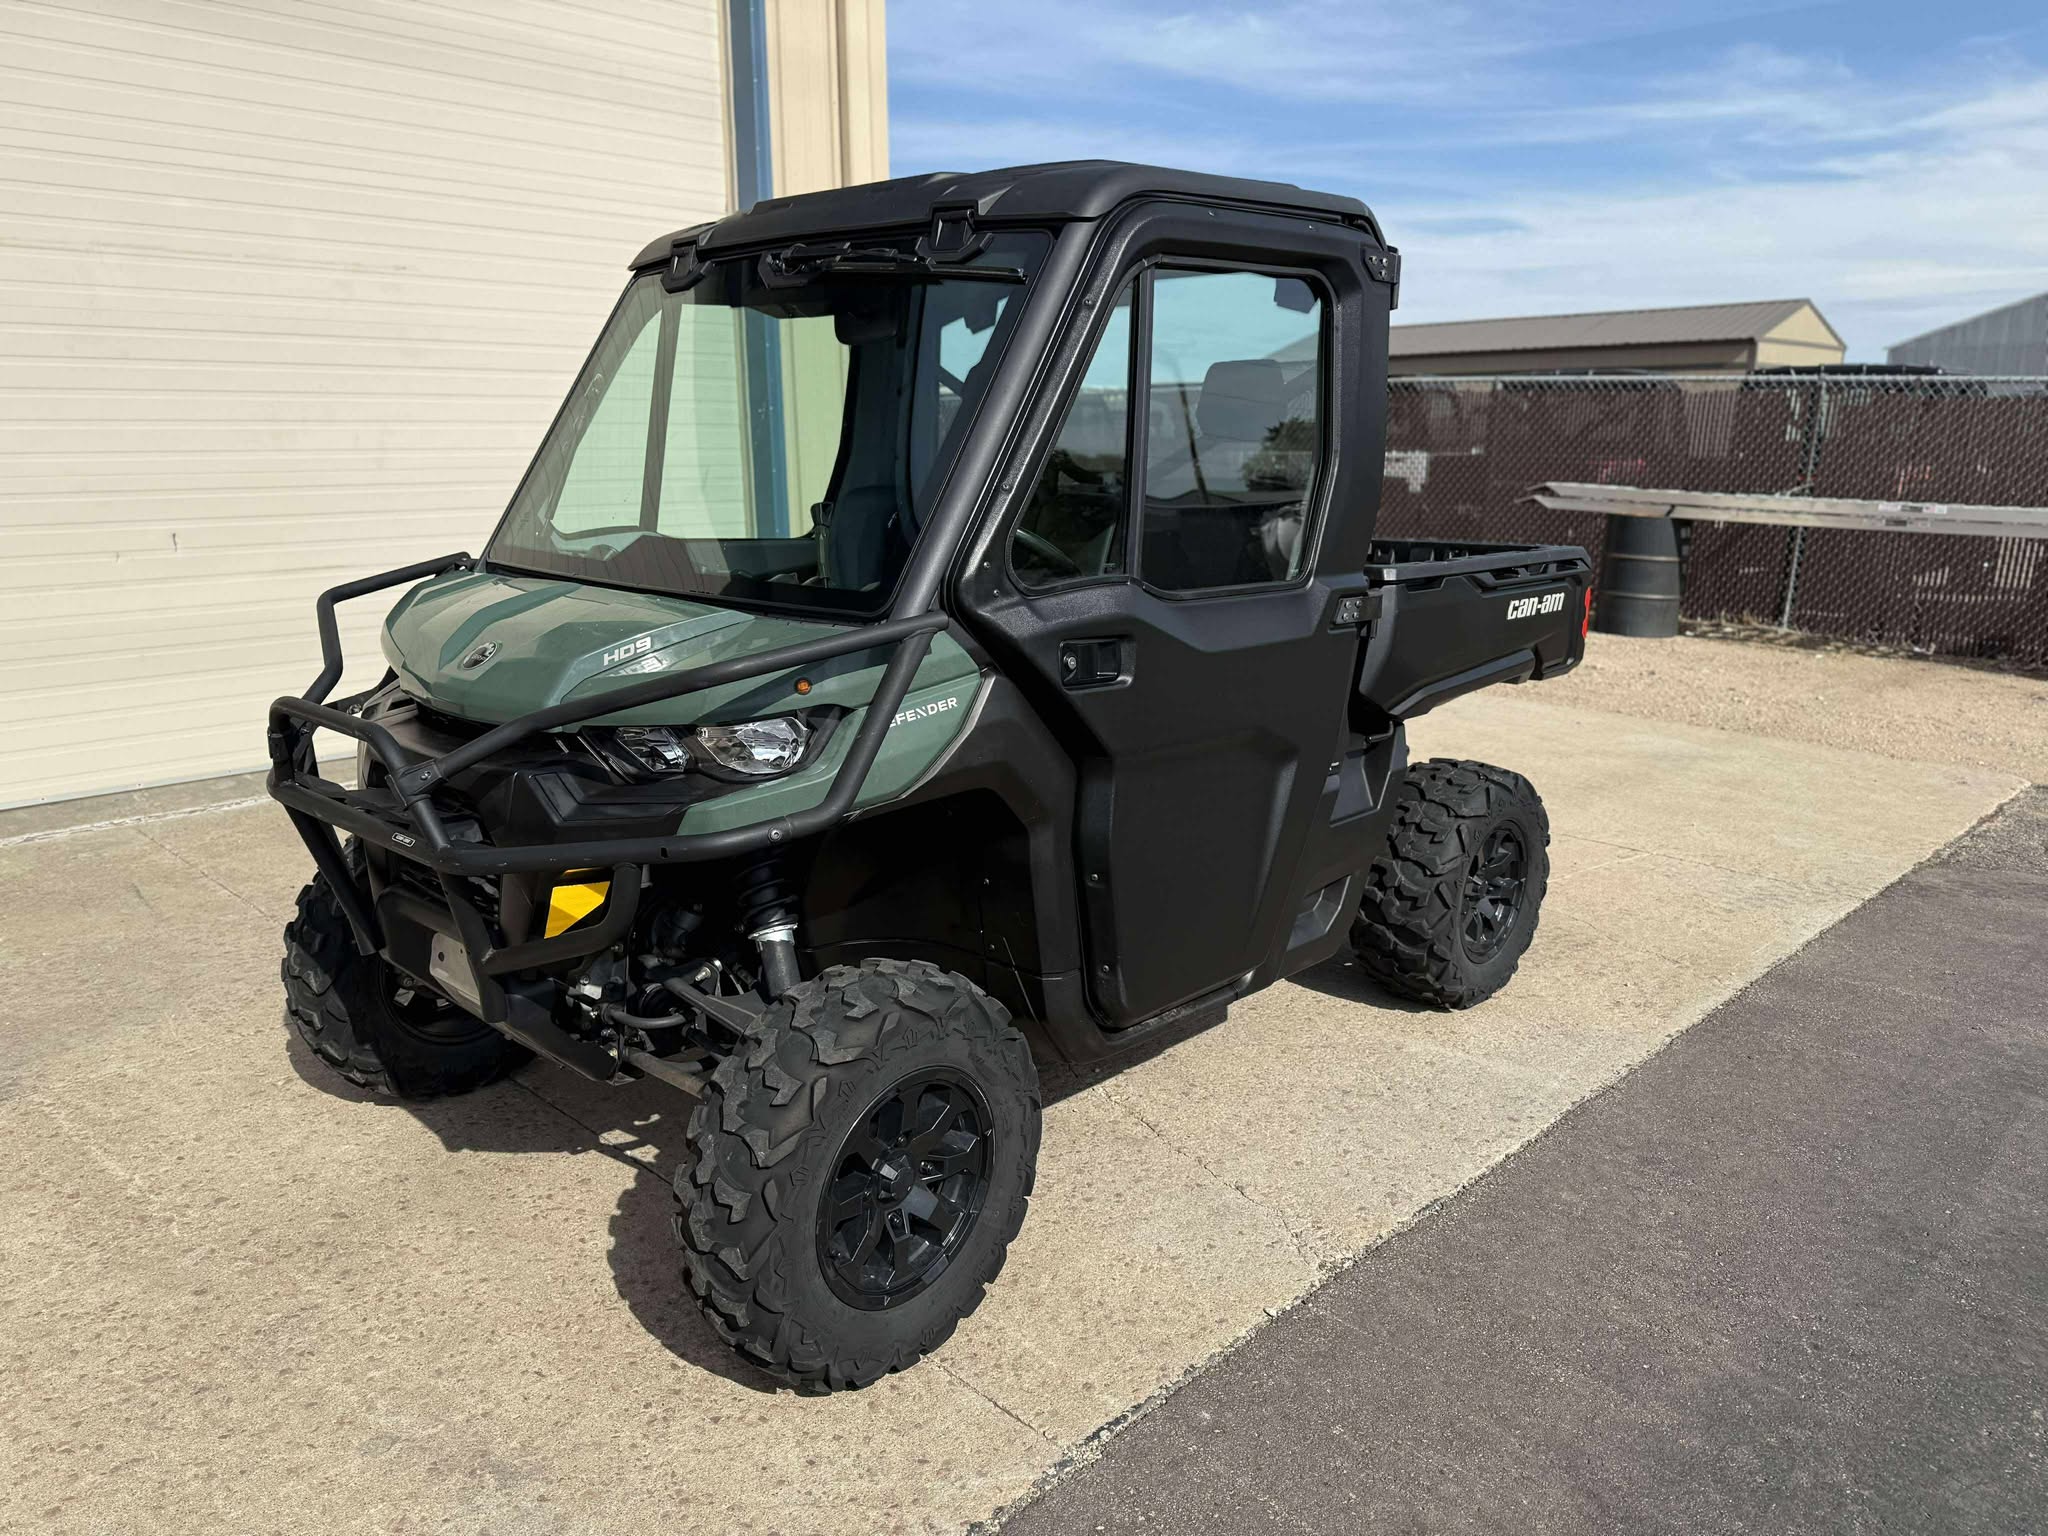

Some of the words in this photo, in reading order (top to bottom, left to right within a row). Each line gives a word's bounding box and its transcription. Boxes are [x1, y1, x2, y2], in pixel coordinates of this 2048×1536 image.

[1506, 592, 1565, 620] can-am
[603, 636, 651, 666] HD9
[889, 697, 958, 728] FENDER
